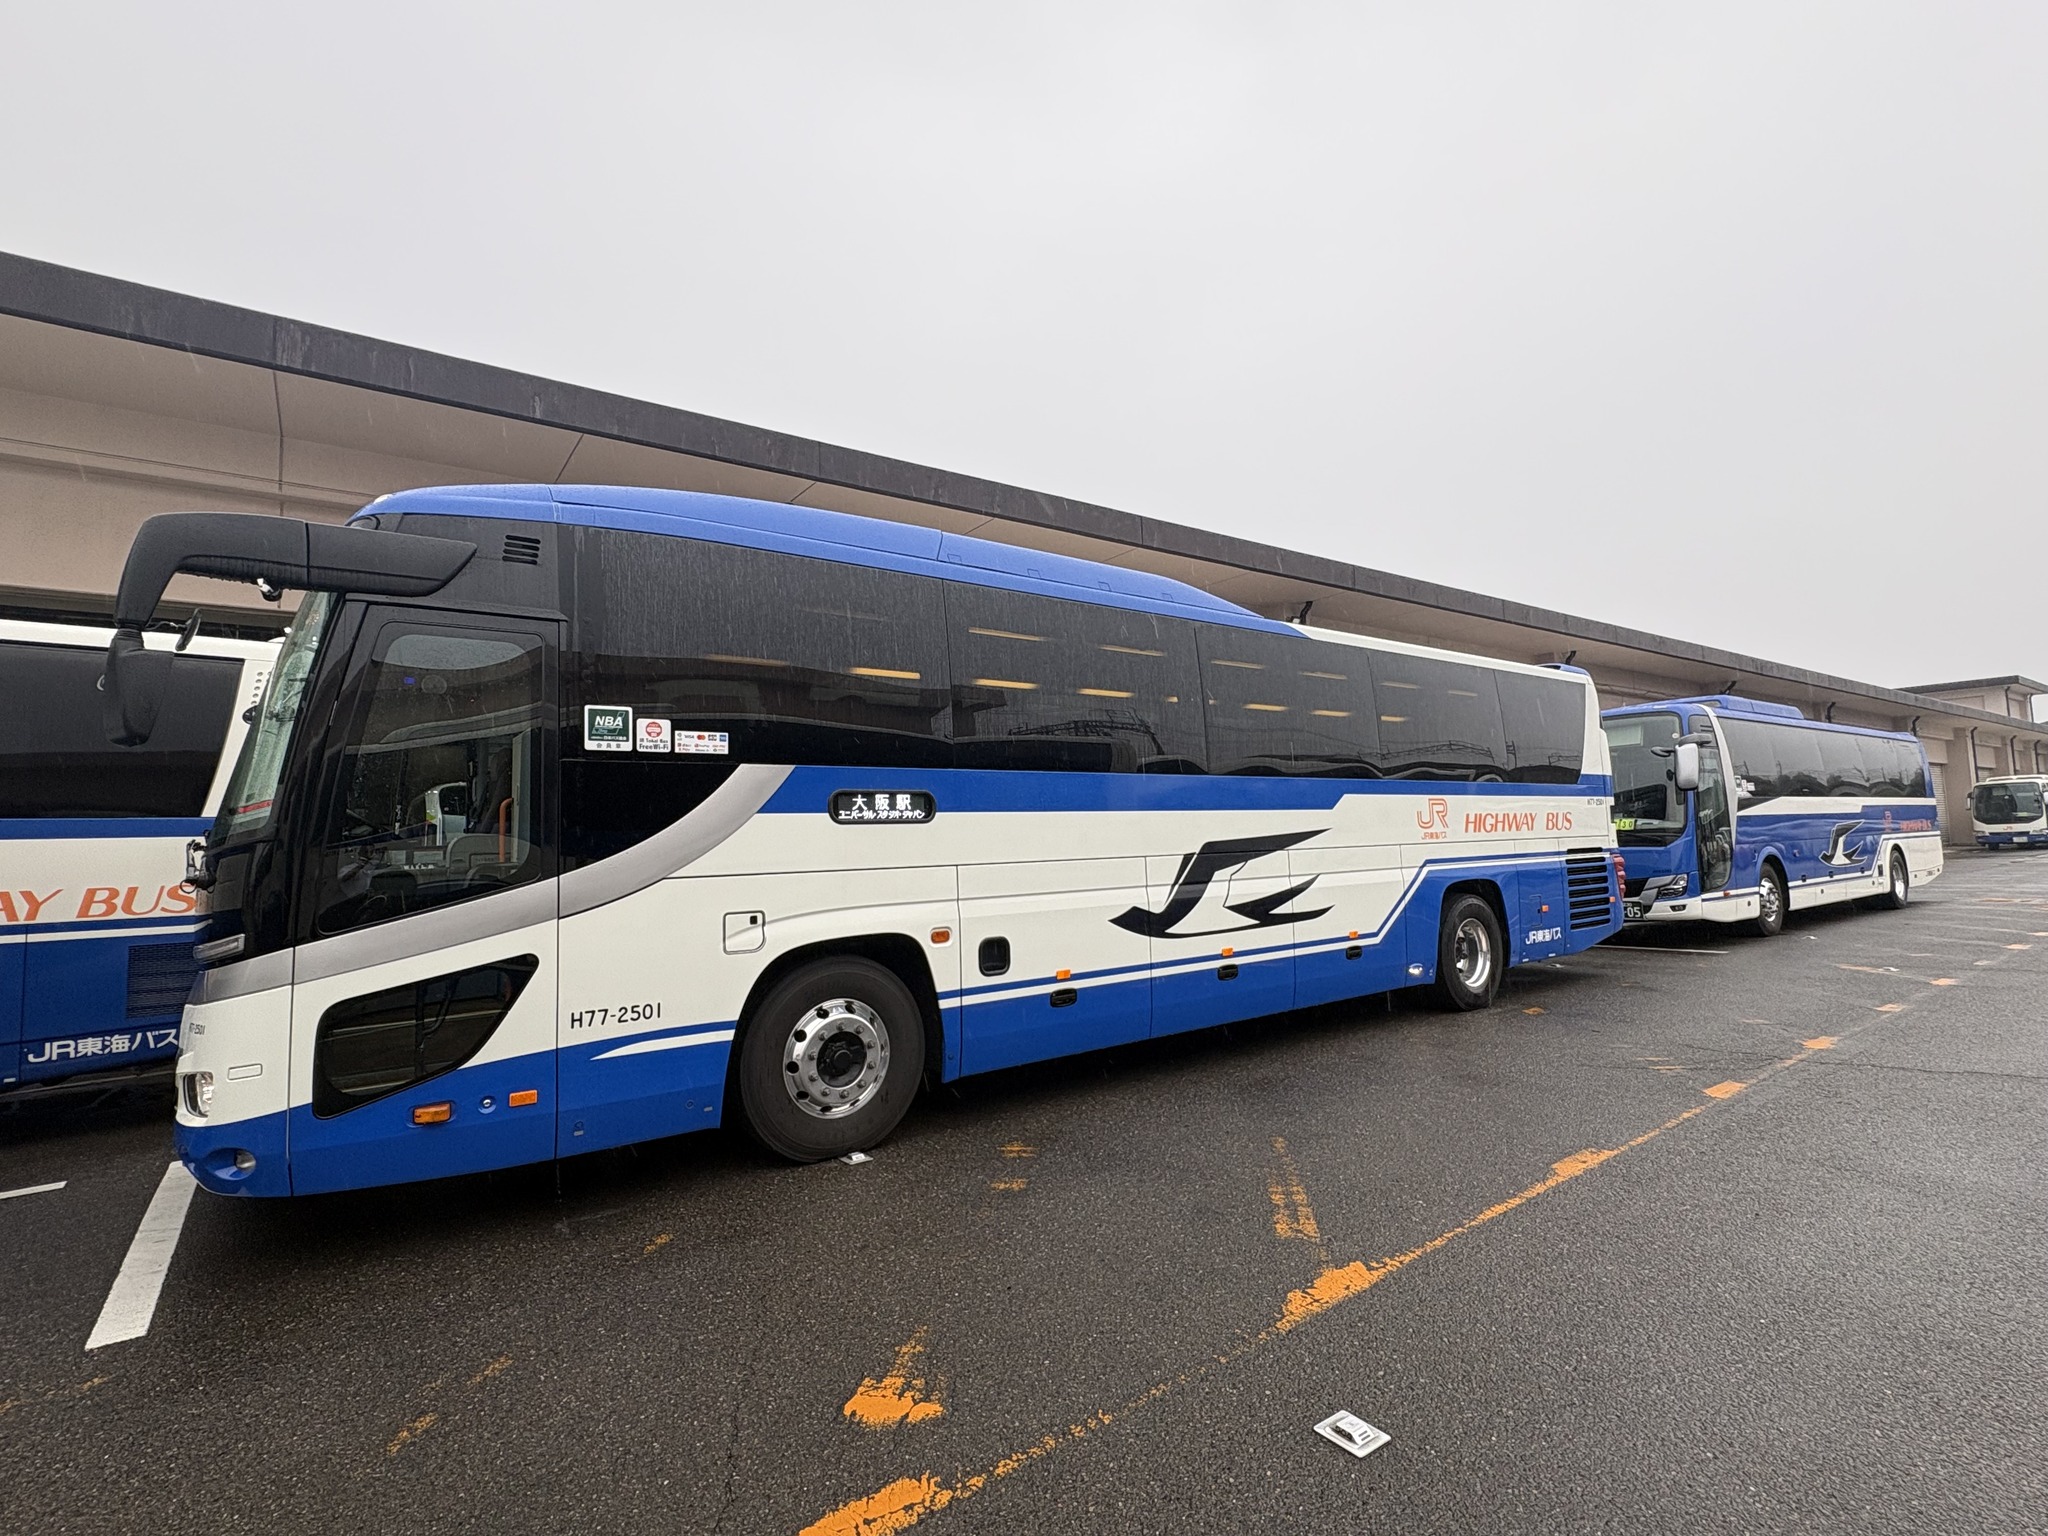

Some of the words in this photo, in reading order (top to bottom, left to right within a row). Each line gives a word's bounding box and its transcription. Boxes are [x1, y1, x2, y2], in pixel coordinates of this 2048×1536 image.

[595, 716, 623, 728] NBA
[852, 794, 912, 811] 大阪駅
[1416, 798, 1449, 829] JR
[1465, 813, 1537, 833] HIGHWAY
[1546, 812, 1573, 831] BUS
[76, 885, 197, 919] BUS
[1525, 926, 1562, 945] JR東海バス
[571, 1002, 661, 1029] H77-2501
[27, 1028, 179, 1063] JR東海バス
